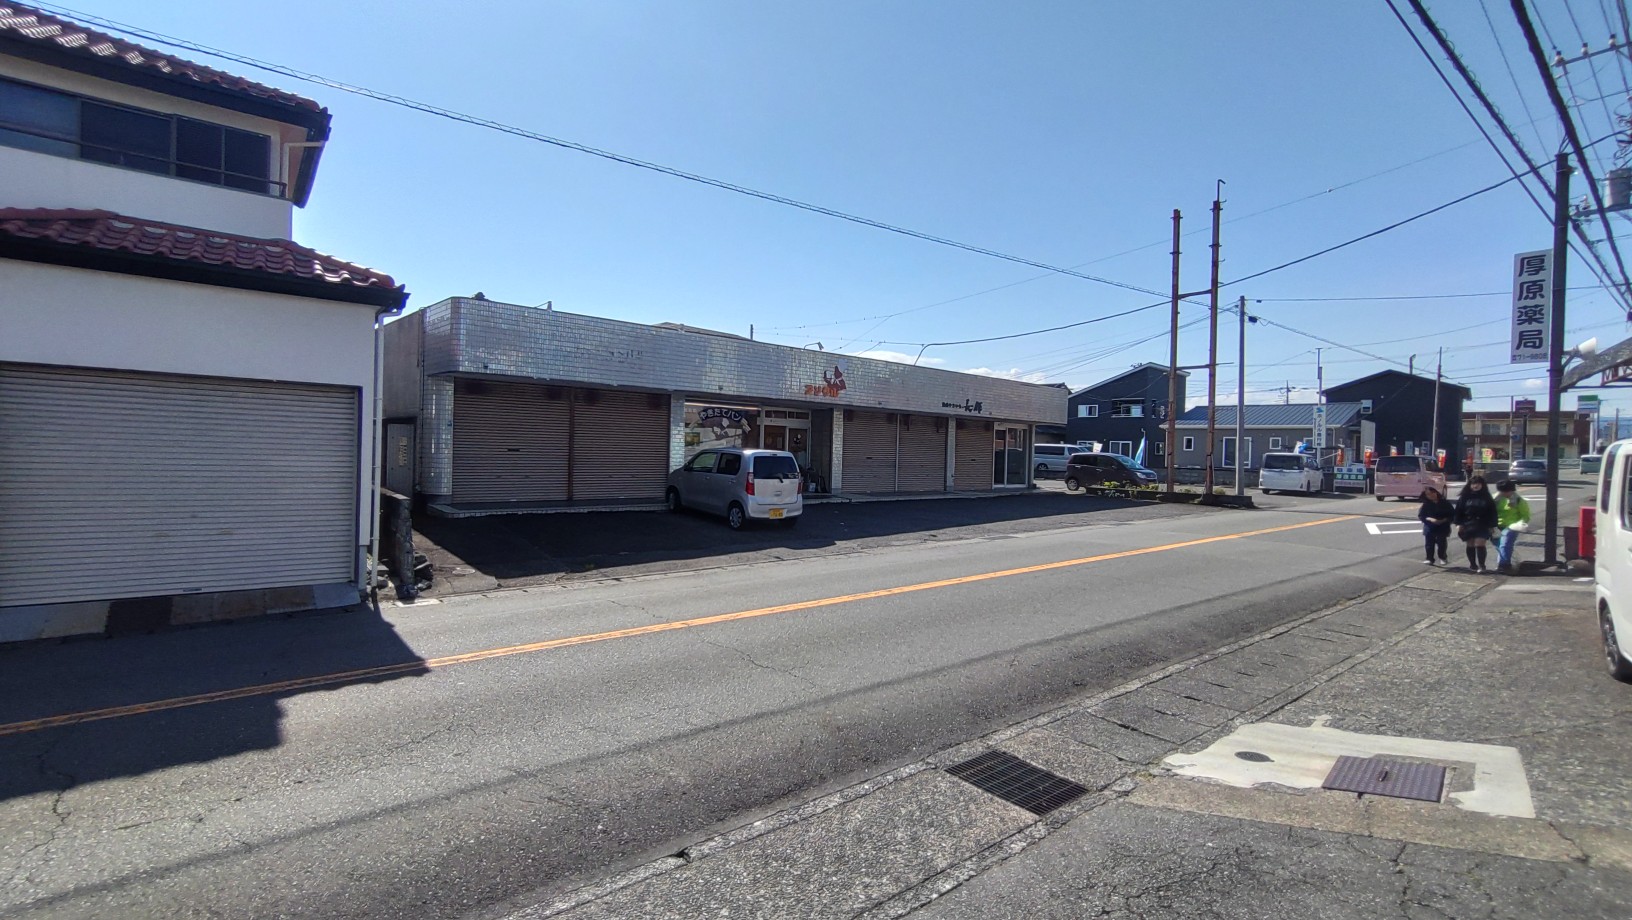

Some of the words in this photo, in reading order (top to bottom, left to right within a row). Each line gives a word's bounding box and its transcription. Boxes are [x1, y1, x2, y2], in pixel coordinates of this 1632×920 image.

[1516, 255, 1547, 350] 厚原薬局
[699, 408, 742, 421] やきたてパン
